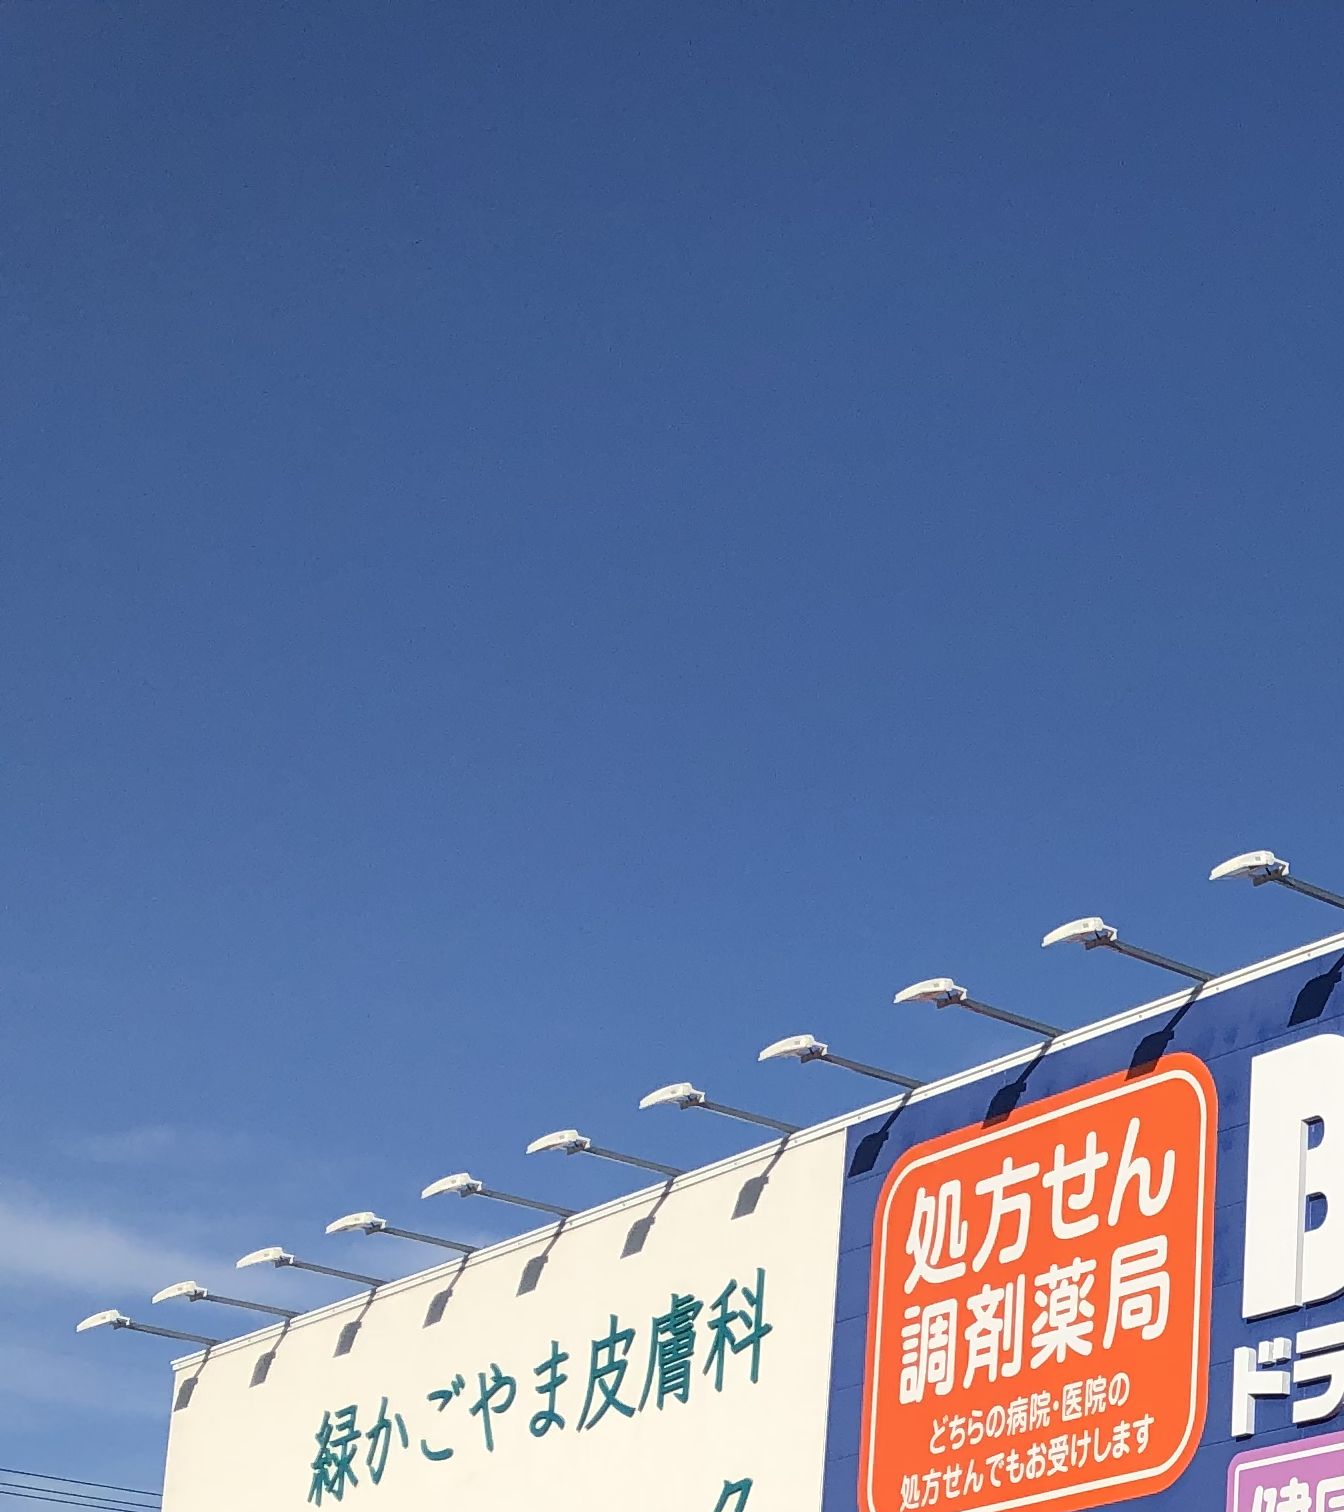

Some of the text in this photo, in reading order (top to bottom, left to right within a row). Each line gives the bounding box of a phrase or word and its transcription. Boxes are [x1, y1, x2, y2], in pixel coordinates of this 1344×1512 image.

[904, 1116, 1176, 1295] 処方せん
[308, 1268, 772, 1507] 緑かごやま皮膚科
[899, 1234, 1170, 1405] 調剤薬局
[899, 1413, 1155, 1512] 処方せんでもお受けします
[929, 1371, 1131, 1455] どちらの病院・医院の
